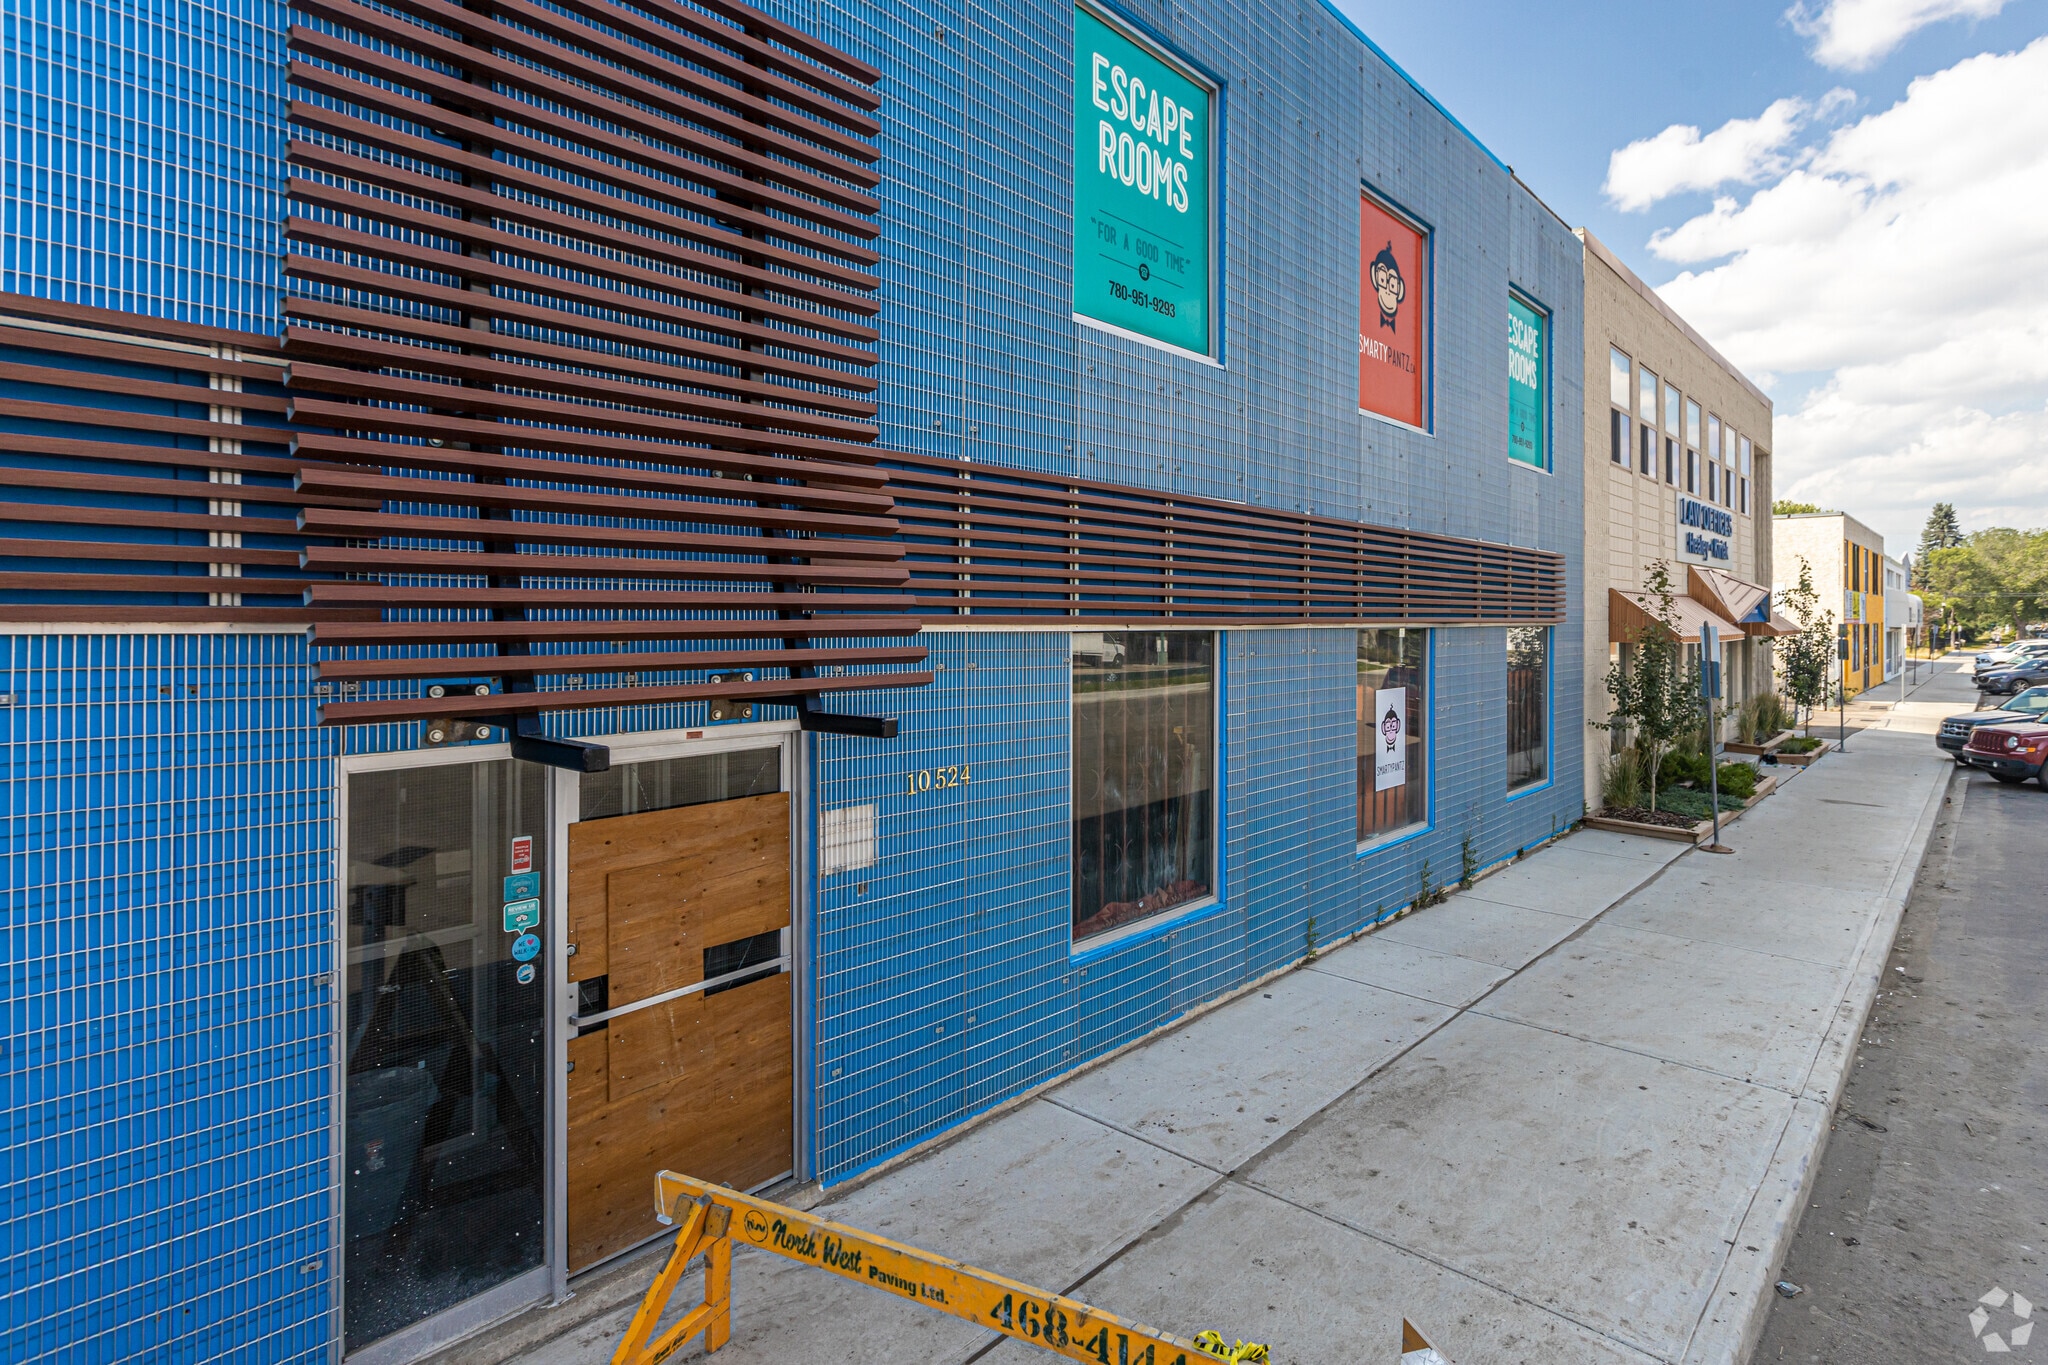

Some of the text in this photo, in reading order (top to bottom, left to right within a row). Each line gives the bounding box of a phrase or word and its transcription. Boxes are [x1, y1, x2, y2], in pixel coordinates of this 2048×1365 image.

[1092, 51, 1194, 160] ESCAPE
[1099, 119, 1189, 213] ROOMS
[1123, 232, 1130, 251] A
[1136, 237, 1159, 264] GOOD
[1108, 279, 1176, 318] 780-951-9293
[1509, 348, 1537, 390] ROOMS
[1680, 498, 1732, 538] LAW OFFICES
[772, 1218, 949, 1305] North West Paving Ltd.
